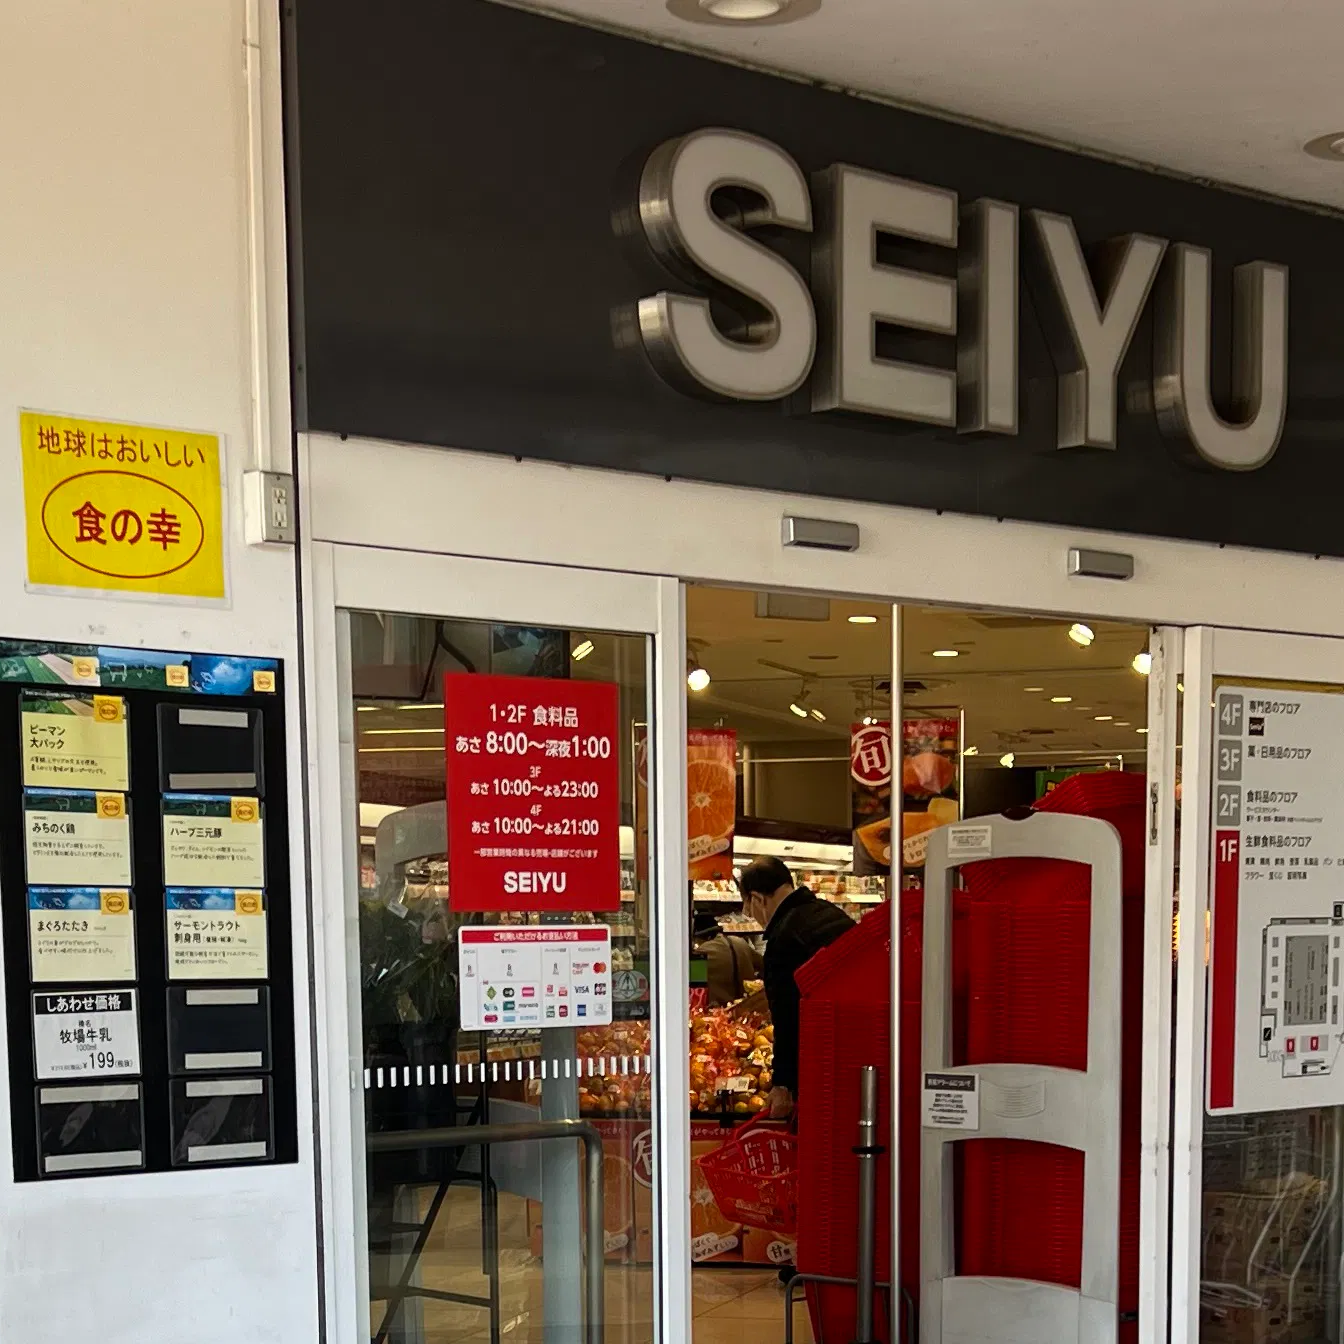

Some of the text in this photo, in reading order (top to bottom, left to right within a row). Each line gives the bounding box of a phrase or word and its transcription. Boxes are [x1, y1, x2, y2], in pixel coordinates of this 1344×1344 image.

[639, 126, 1290, 471] SEIYU
[37, 425, 205, 468] 地球はおいしい
[72, 501, 181, 551] 食の幸
[532, 704, 579, 728] 食料品
[1221, 702, 1241, 726] 4F
[29, 724, 66, 736] ピーマン
[29, 737, 65, 750] 大パック
[456, 735, 481, 753] あさ
[856, 735, 891, 776] 旬
[1219, 747, 1240, 771] 3F
[529, 765, 542, 778] 3F
[470, 781, 490, 796] あさ
[530, 803, 543, 817] 4F
[1219, 793, 1239, 817] 2F
[471, 820, 490, 834] あさ
[1219, 839, 1238, 863] 1F
[504, 870, 567, 894] SEIYU
[37, 920, 88, 932] まぐろたたき
[173, 920, 241, 931] サーモントラウト
[574, 986, 590, 994] VISA
[46, 994, 122, 1012] しあわせ価格
[60, 1027, 113, 1044] 牧場牛乳
